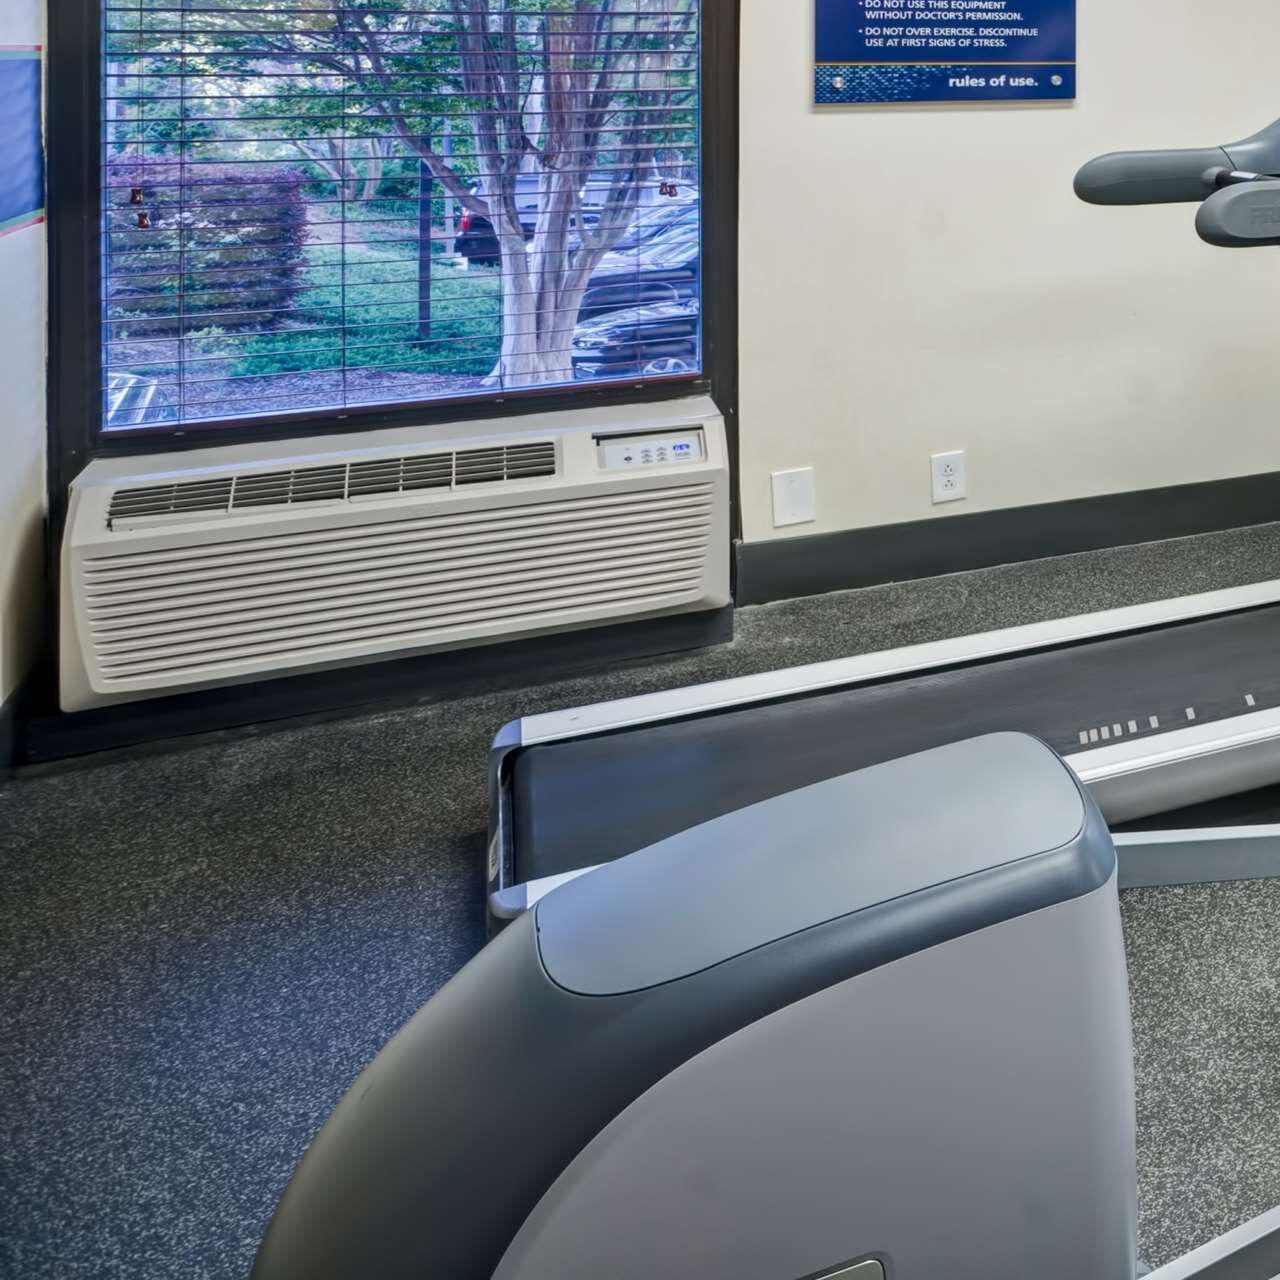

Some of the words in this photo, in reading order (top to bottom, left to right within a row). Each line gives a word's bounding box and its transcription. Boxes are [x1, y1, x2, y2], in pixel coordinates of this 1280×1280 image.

[865, 0, 881, 8] DO
[884, 0, 905, 8] NOT
[928, 1, 949, 9] THIS
[951, 1, 1006, 10] EQUIPMENT
[865, 11, 912, 19] WITHOUT
[915, 12, 963, 20] DOCTOR'S
[965, 12, 1023, 20] PERMISSION.
[905, 28, 931, 36] OVER
[933, 28, 977, 36] EXERCISE.
[979, 28, 1038, 36] DISCONTINUE
[929, 39, 956, 47] SIGNS
[958, 39, 971, 47] OF
[973, 39, 1007, 47] STRESS.
[949, 76, 985, 86] rules
[990, 75, 1006, 86] of
[1009, 77, 1038, 86] use.
